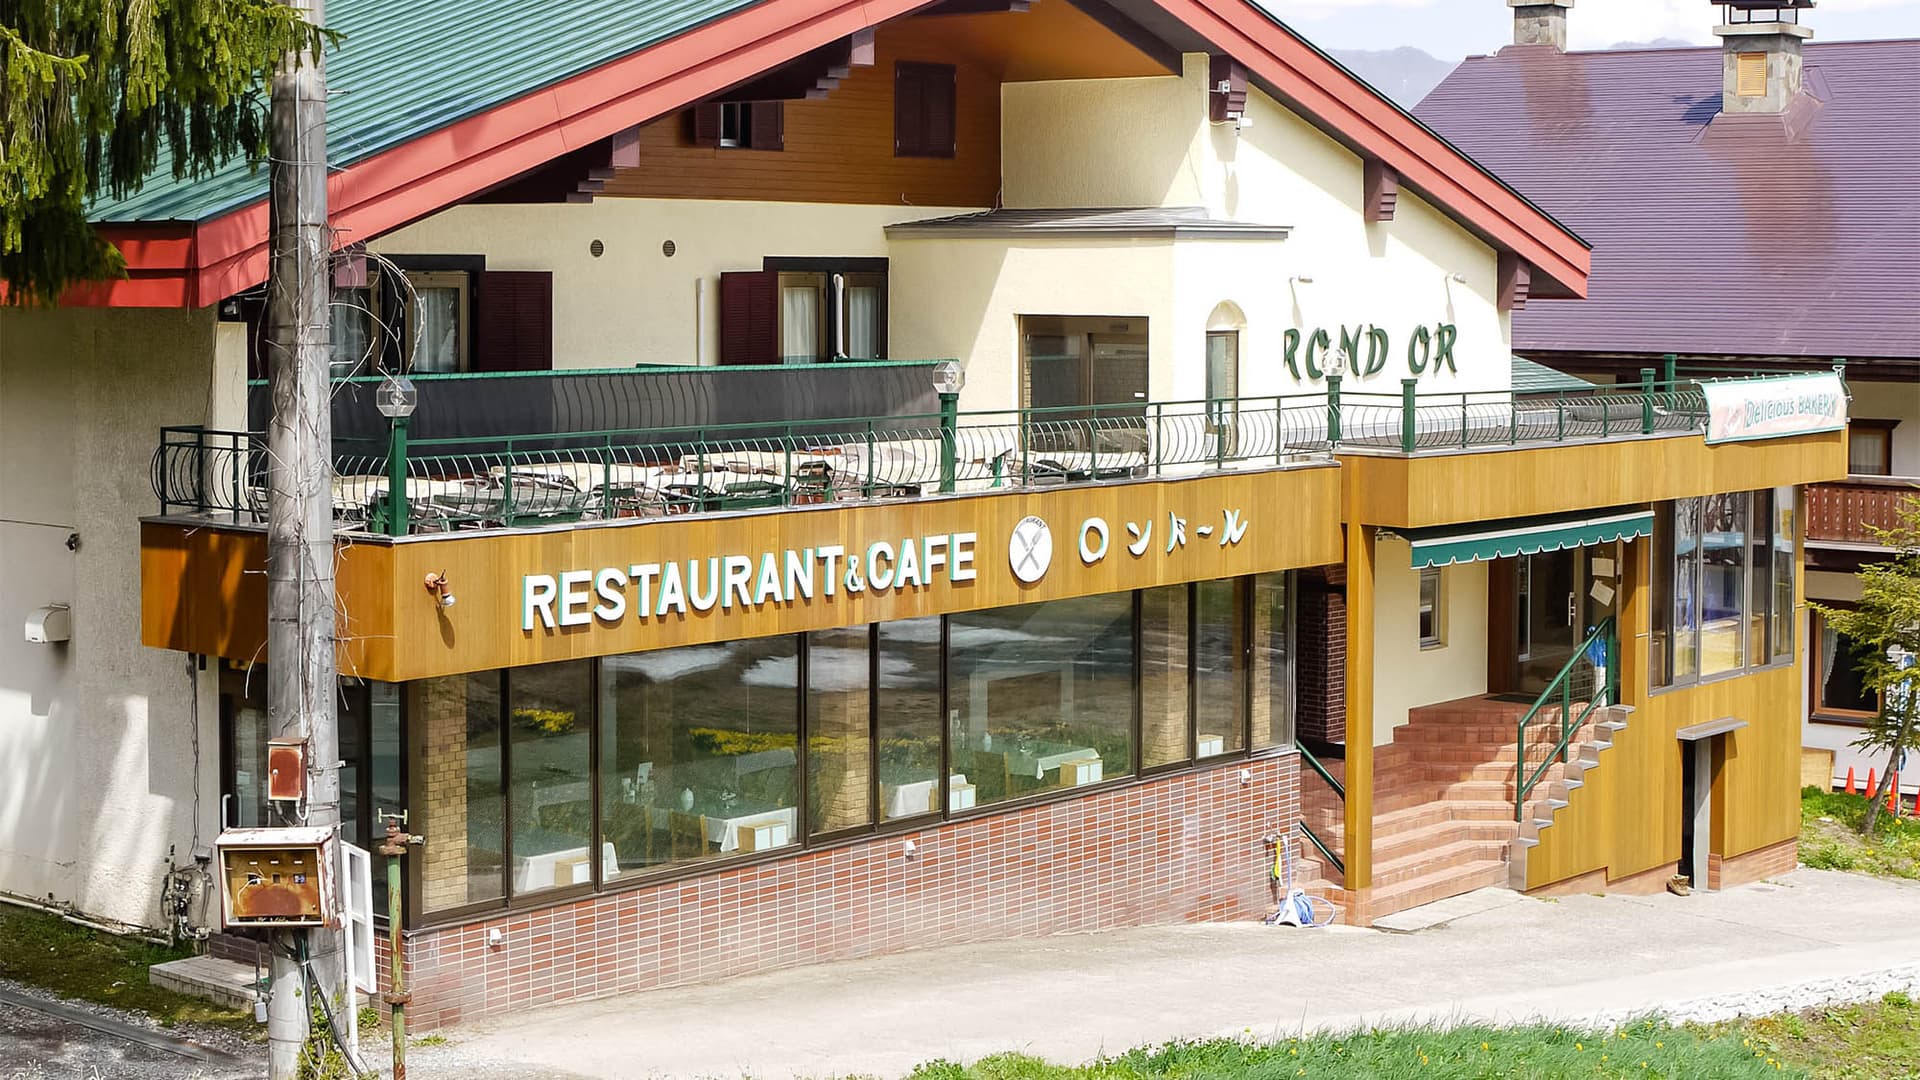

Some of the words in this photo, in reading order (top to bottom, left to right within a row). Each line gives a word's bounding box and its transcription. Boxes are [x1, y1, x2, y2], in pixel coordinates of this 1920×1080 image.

[1283, 324, 1389, 380] ROND
[1408, 322, 1458, 375] OR
[1798, 393, 1838, 418] BAKERY
